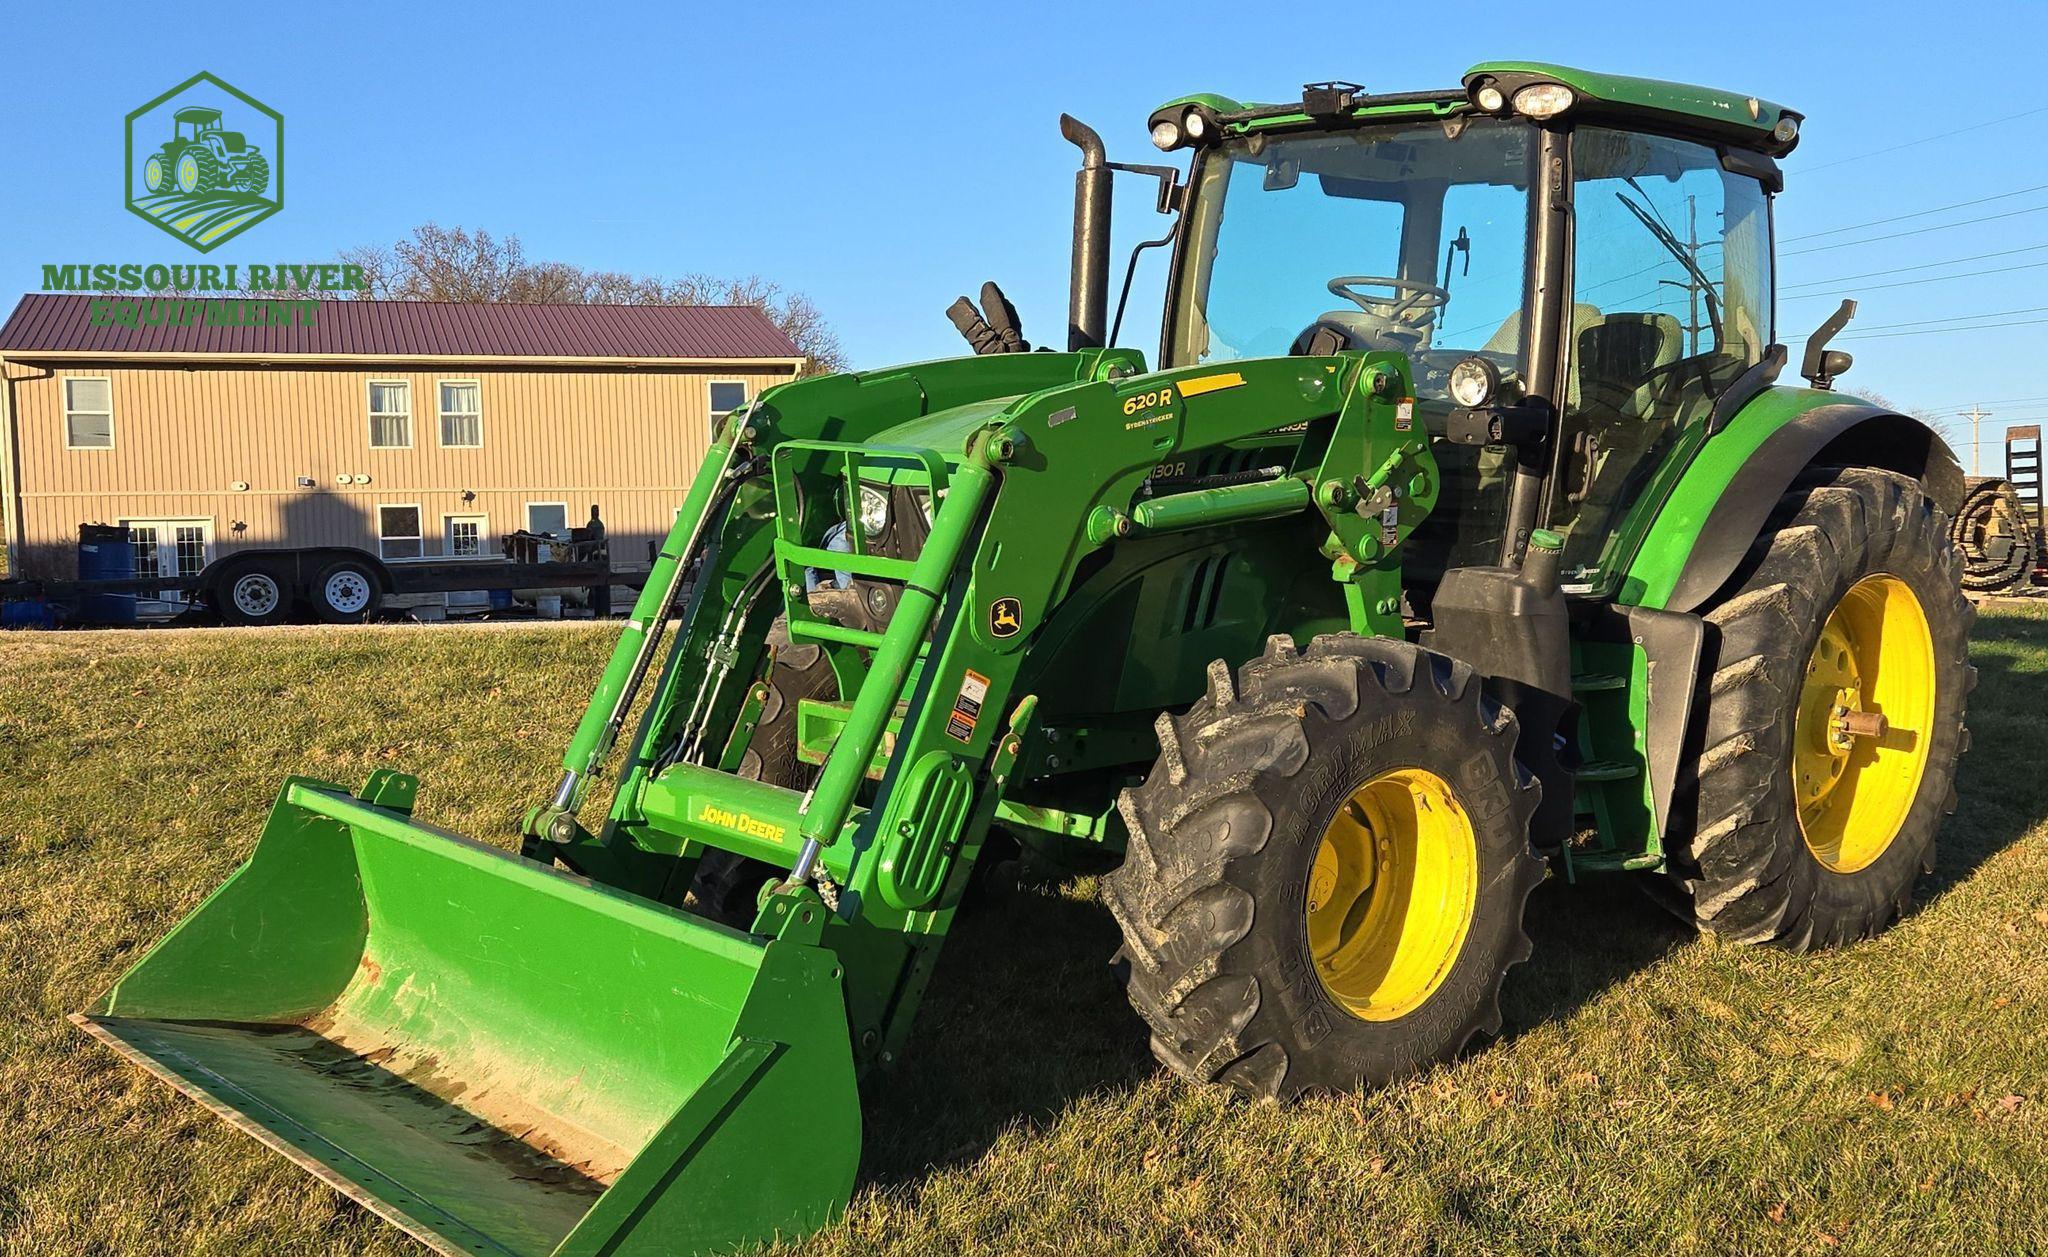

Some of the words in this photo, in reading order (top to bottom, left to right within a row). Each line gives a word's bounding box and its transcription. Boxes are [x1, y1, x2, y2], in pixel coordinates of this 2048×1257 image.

[1123, 392, 1157, 415] 620
[1160, 388, 1172, 407] R
[1149, 464, 1174, 480] 130
[1175, 462, 1186, 477] R
[699, 804, 738, 829] JOHN
[737, 813, 785, 844] DEERE
